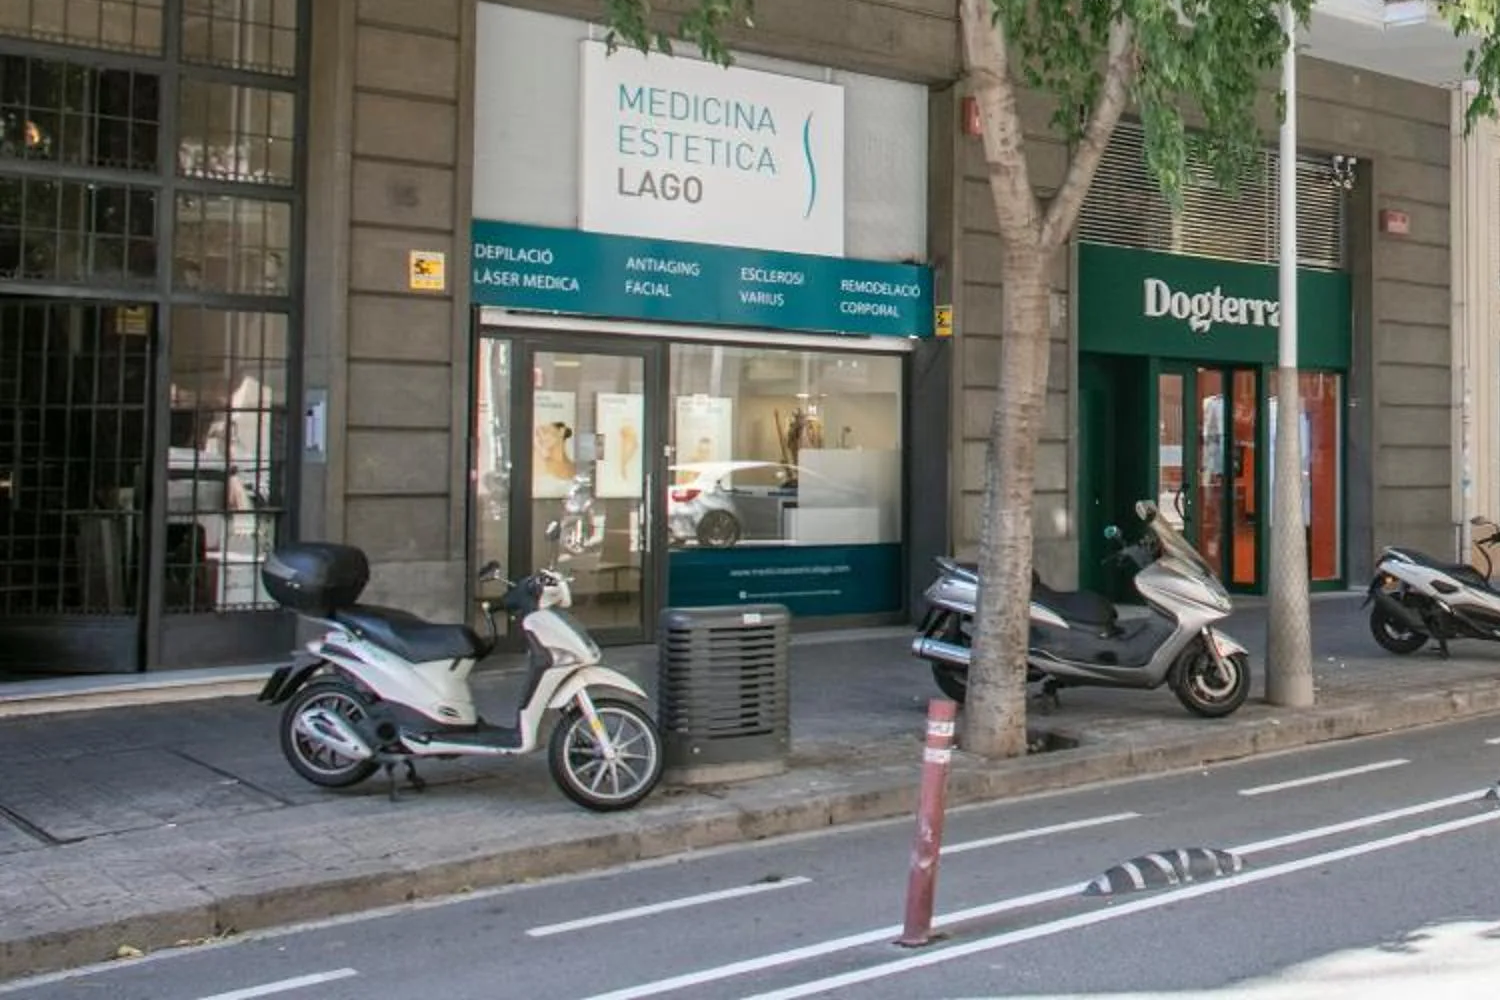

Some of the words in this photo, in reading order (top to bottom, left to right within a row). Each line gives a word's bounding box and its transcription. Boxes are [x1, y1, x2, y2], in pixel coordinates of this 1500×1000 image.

[619, 83, 777, 136] MEDICINA
[618, 125, 777, 174] ESTETICA
[618, 167, 703, 204] LAGO
[474, 243, 553, 265] DEPILACIÓ
[626, 257, 700, 276] ANTIAGING
[625, 280, 672, 297] FACIAL
[841, 279, 921, 298] REMODELACIÓ
[840, 301, 900, 318] CORPORAL
